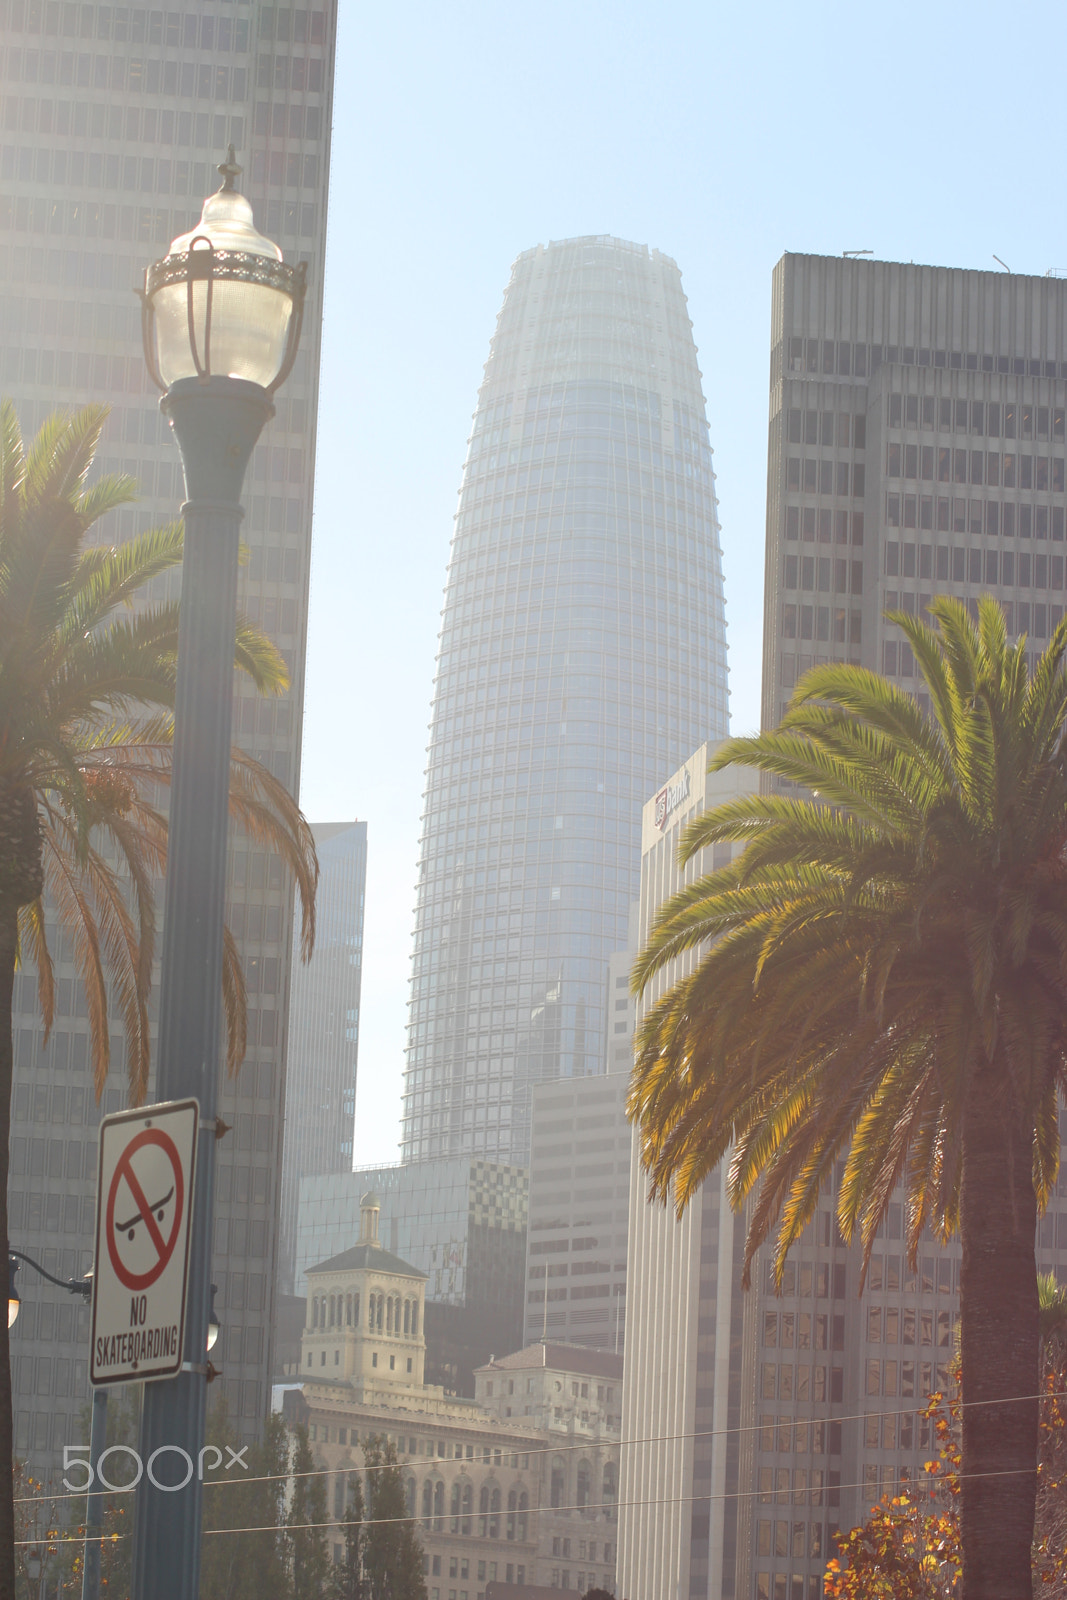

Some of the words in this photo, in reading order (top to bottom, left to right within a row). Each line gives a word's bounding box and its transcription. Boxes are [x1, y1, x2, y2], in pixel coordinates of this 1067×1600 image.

[667, 769, 688, 815] bank
[130, 1295, 147, 1327] NO
[97, 1325, 178, 1367] SKATEBOARDING
